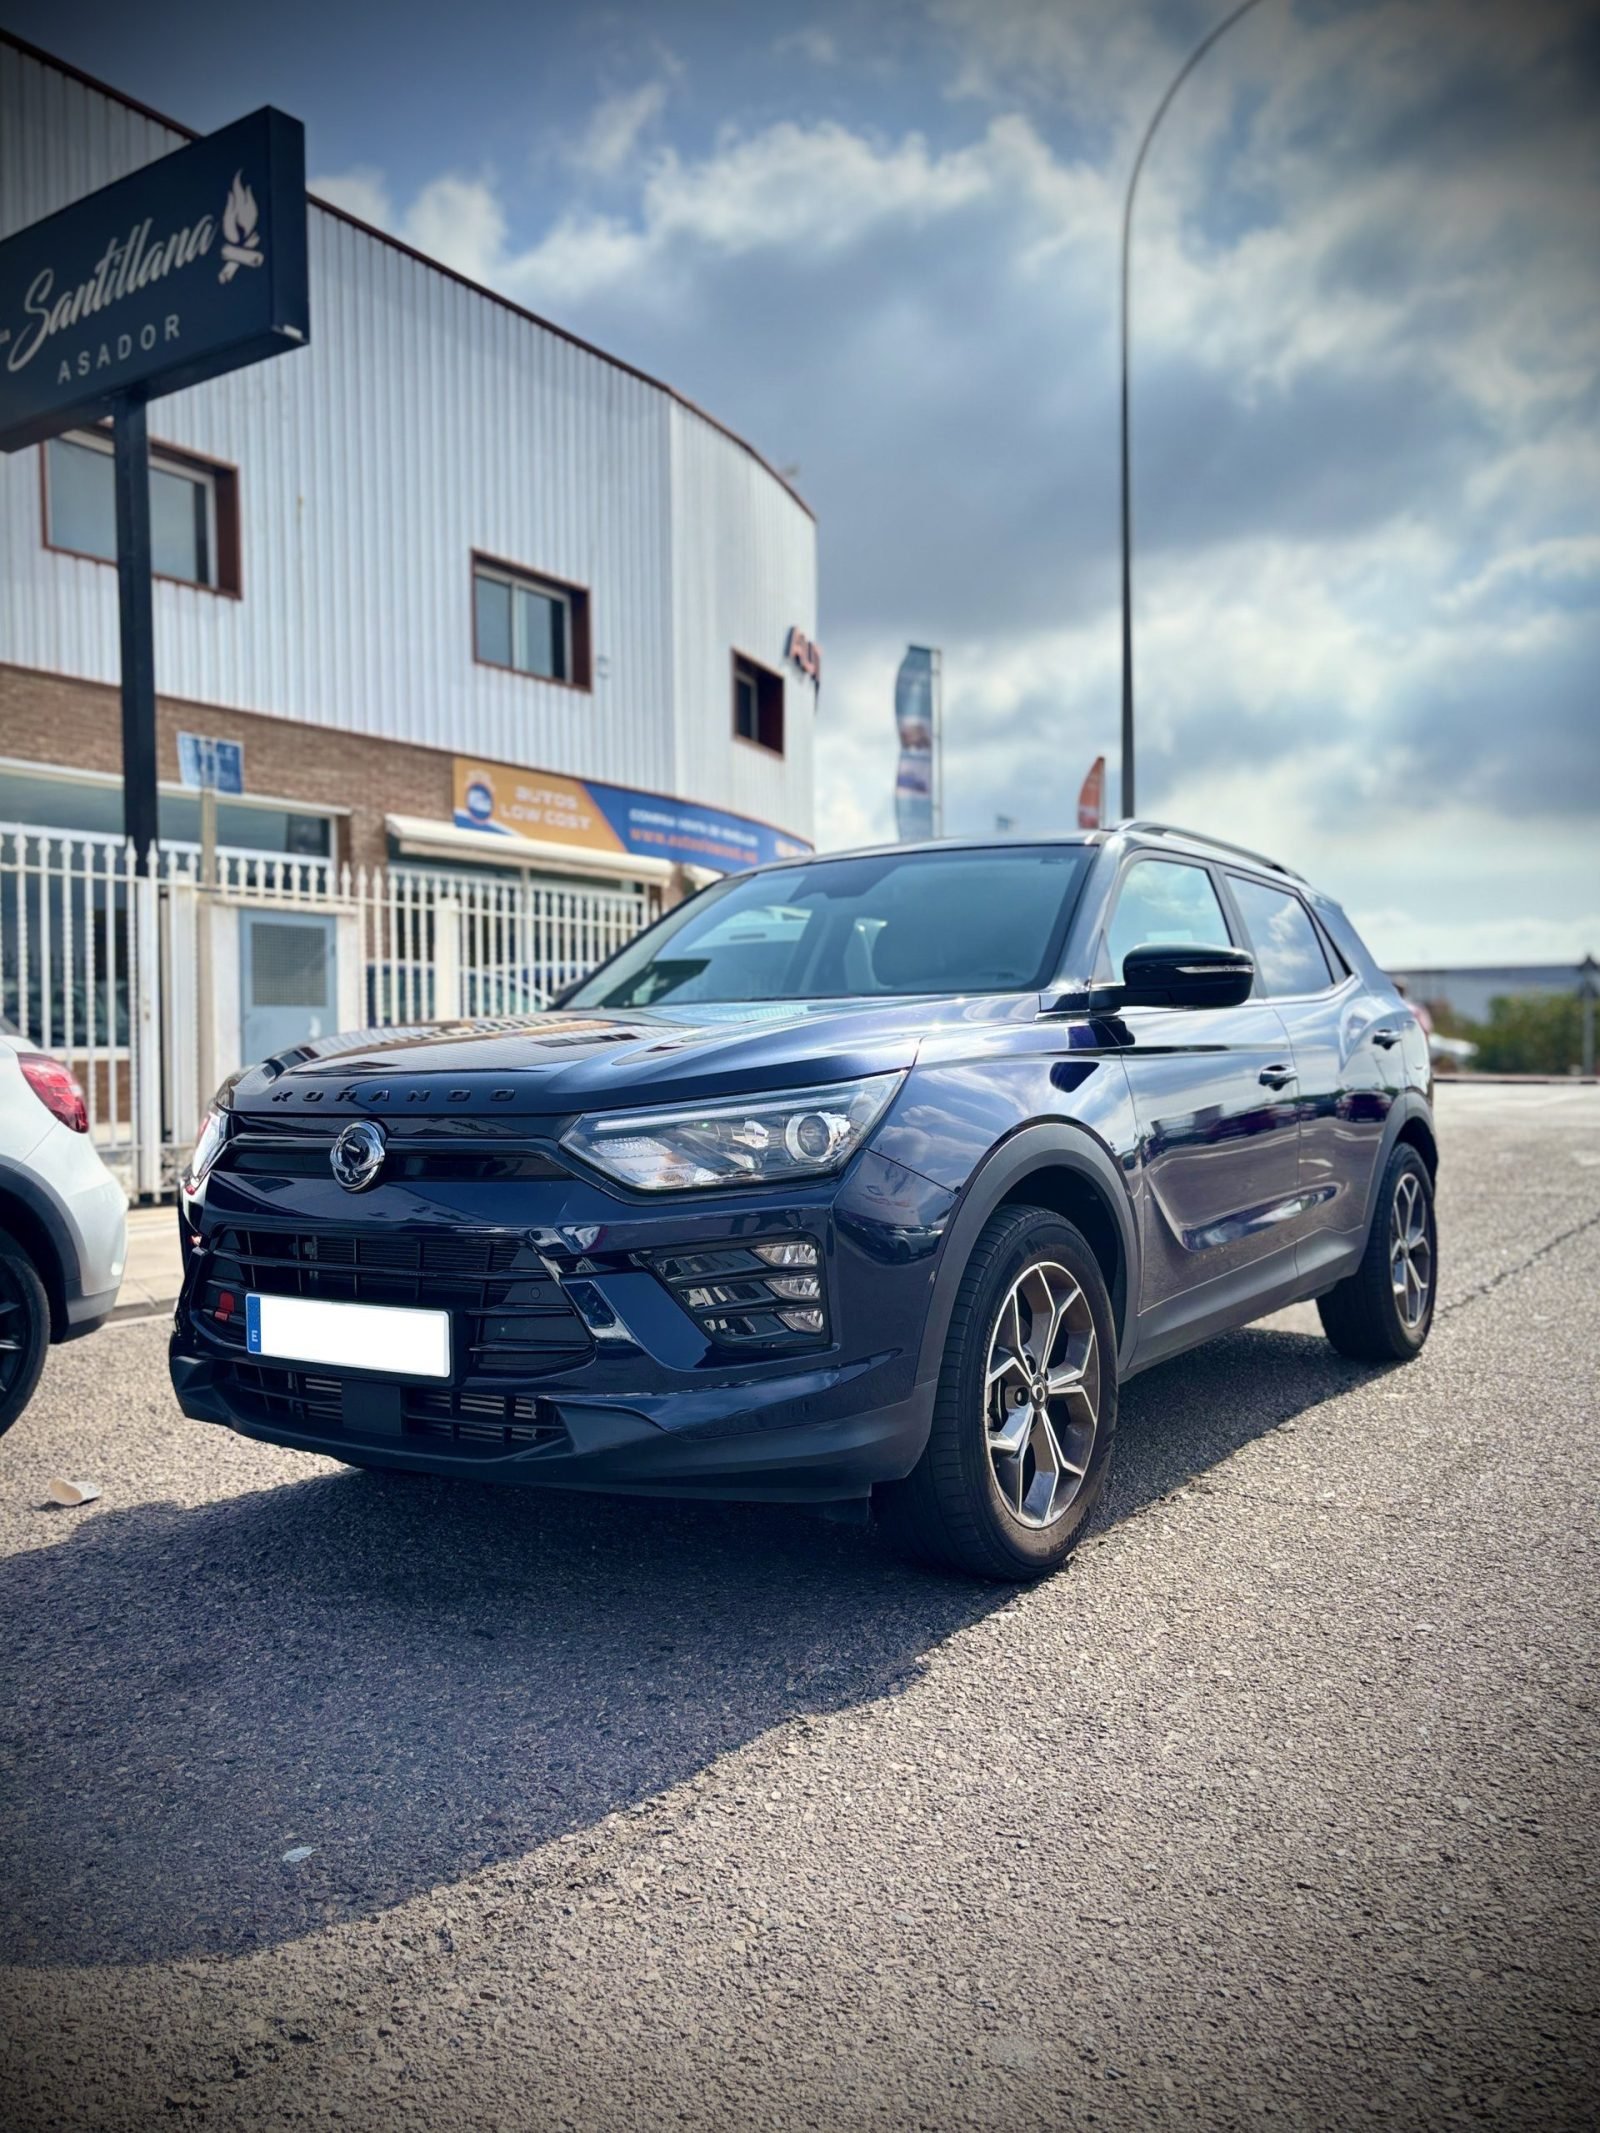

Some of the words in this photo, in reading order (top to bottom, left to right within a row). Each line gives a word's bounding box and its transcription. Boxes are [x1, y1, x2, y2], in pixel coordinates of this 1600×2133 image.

[8, 214, 216, 372] Santillana
[57, 314, 180, 384] ASADOR
[499, 803, 540, 824] LOW
[543, 810, 591, 832] COST
[272, 1089, 516, 1103] KORANDO
[251, 1329, 259, 1343] E
